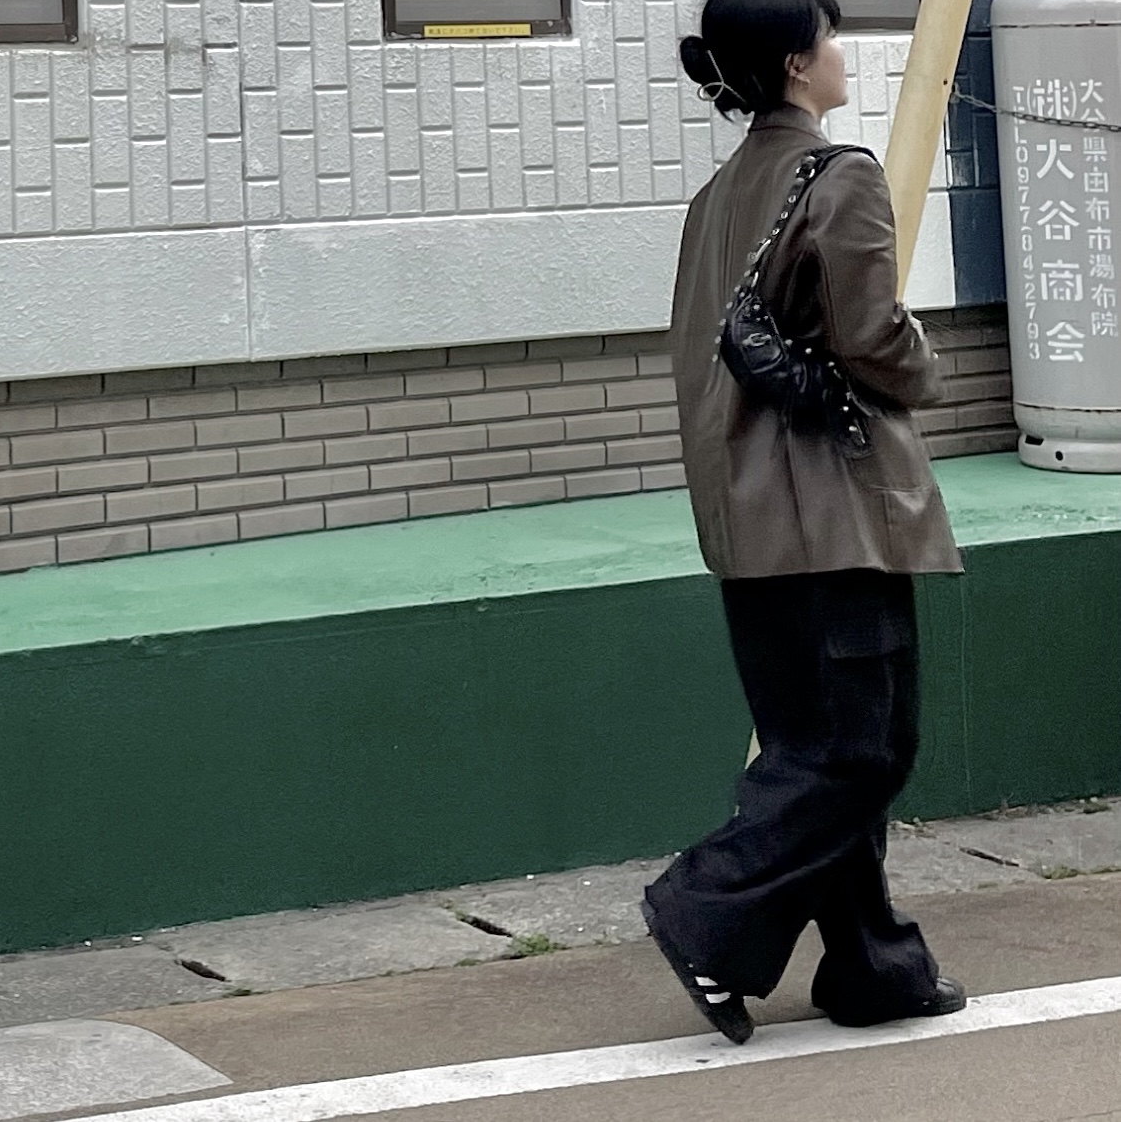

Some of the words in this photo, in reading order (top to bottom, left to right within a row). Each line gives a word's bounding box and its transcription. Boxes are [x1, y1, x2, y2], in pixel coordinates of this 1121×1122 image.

[1027, 78, 1085, 362] (株)大谷商会
[1080, 79, 1119, 338] 大分県由布市湯布院
